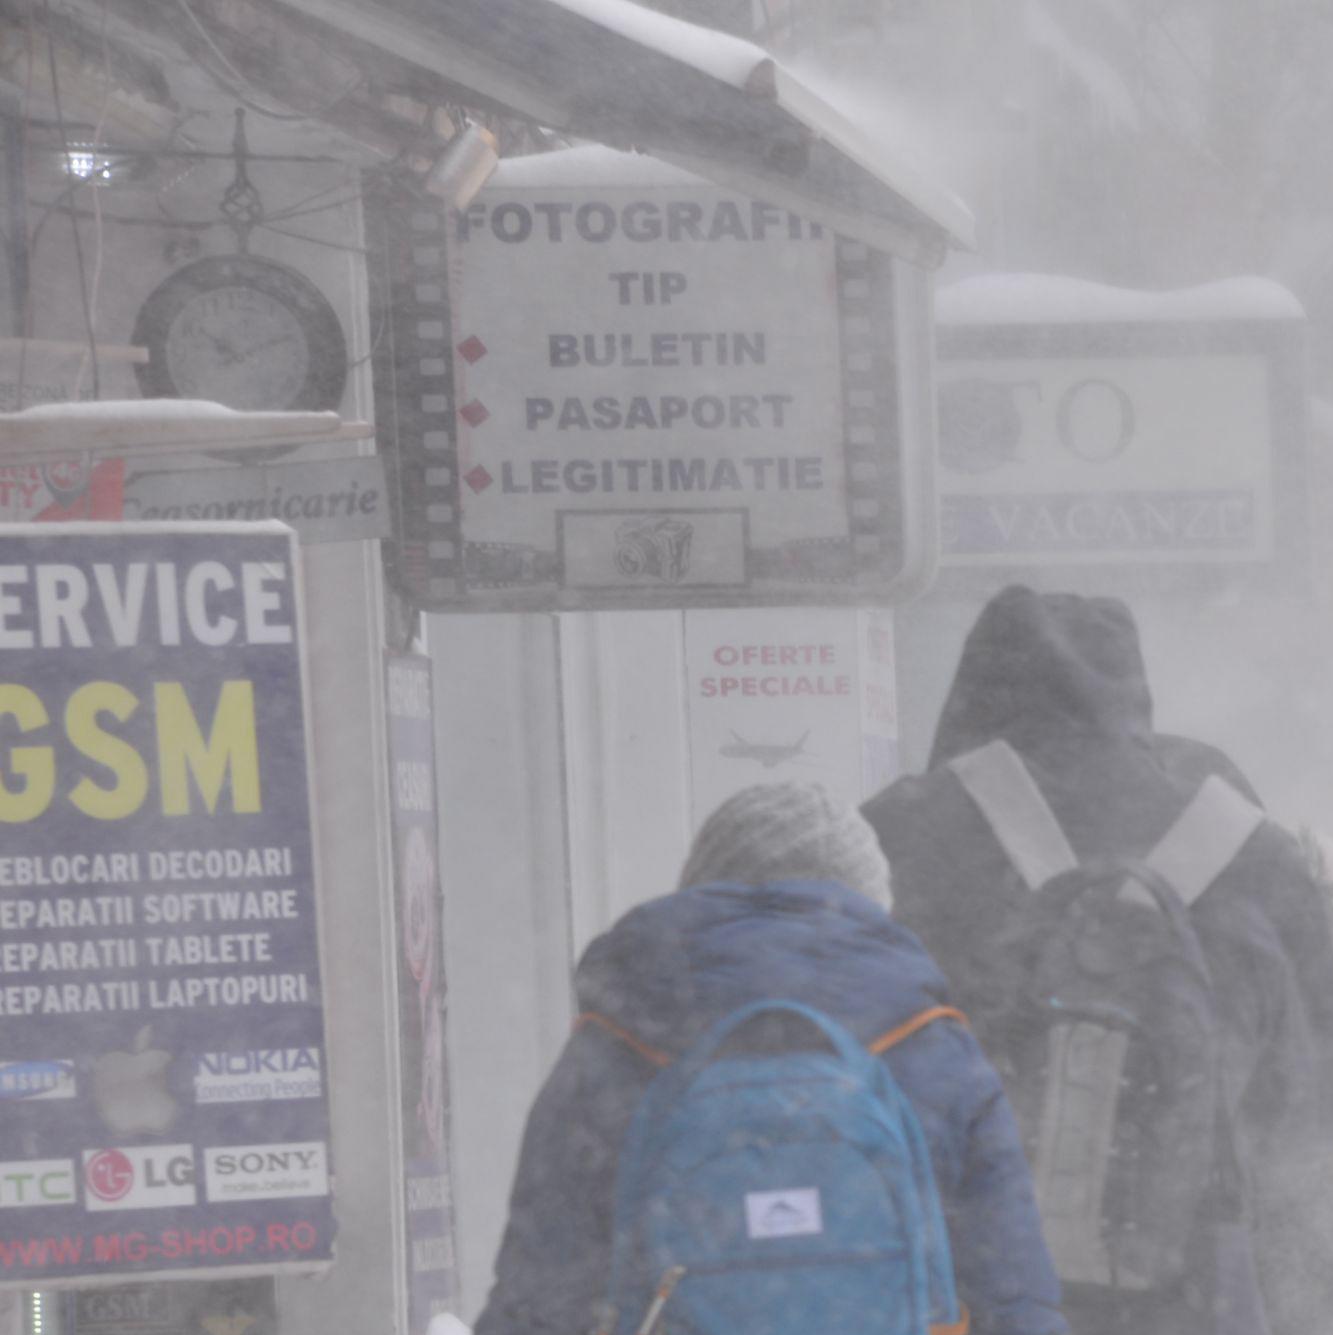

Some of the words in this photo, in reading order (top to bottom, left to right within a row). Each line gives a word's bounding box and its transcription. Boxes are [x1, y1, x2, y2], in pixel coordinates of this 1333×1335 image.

[609, 271, 688, 305] TIP
[547, 332, 767, 368] BULETIN
[524, 394, 794, 431] PASAPORT
[501, 456, 825, 494] LEGITIMATIE
[712, 644, 837, 668] OFERTE
[699, 675, 852, 698] SPECIALE
[0, 679, 262, 824] GSM
[150, 848, 292, 881] DECODARI
[144, 890, 299, 924] SOFTWARE
[0, 938, 137, 973] EPARATII
[145, 933, 272, 966] TABLETE
[0, 981, 140, 1016] EPARATII
[149, 974, 308, 1009] LAPTOPURI
[199, 1047, 319, 1077] NOKIA
[144, 1156, 196, 1189] LG
[214, 1151, 317, 1176] SONY
[0, 1171, 71, 1203] TC
